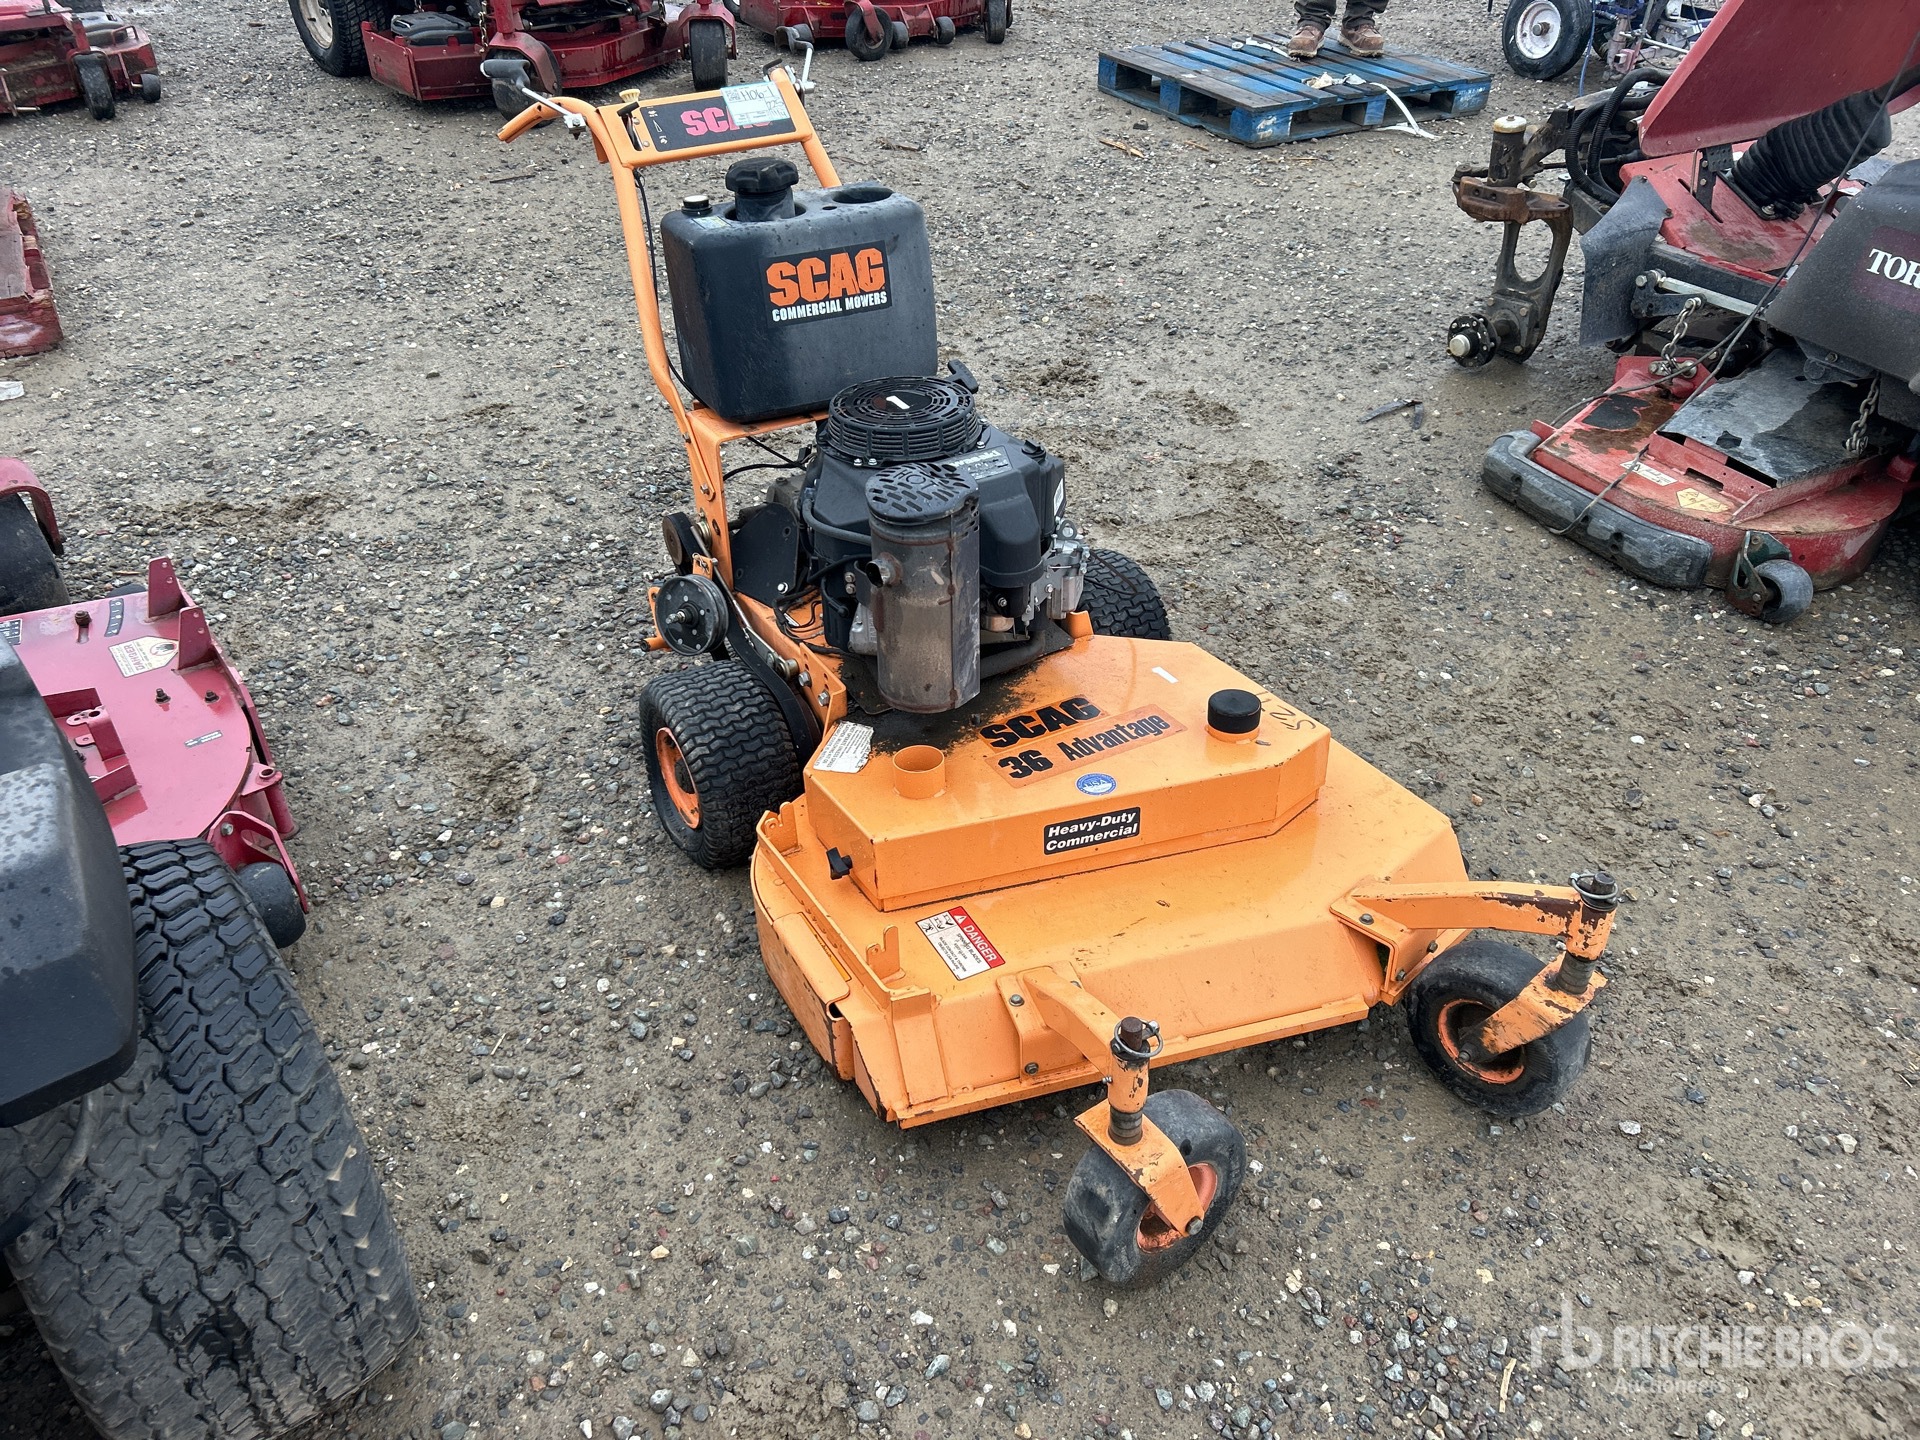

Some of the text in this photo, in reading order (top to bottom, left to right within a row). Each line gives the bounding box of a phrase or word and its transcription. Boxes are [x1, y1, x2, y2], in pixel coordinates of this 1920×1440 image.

[766, 247, 886, 306] SCAG
[772, 291, 888, 322] COMMERCIAL MOWERS
[893, 468, 939, 490] HOT
[980, 697, 1101, 748] SCAG
[998, 715, 1171, 778] 36 Advantage
[1045, 823, 1138, 851] Commercial
[1048, 811, 1137, 837] Heavy-Duty
[963, 925, 998, 962] DANGER
